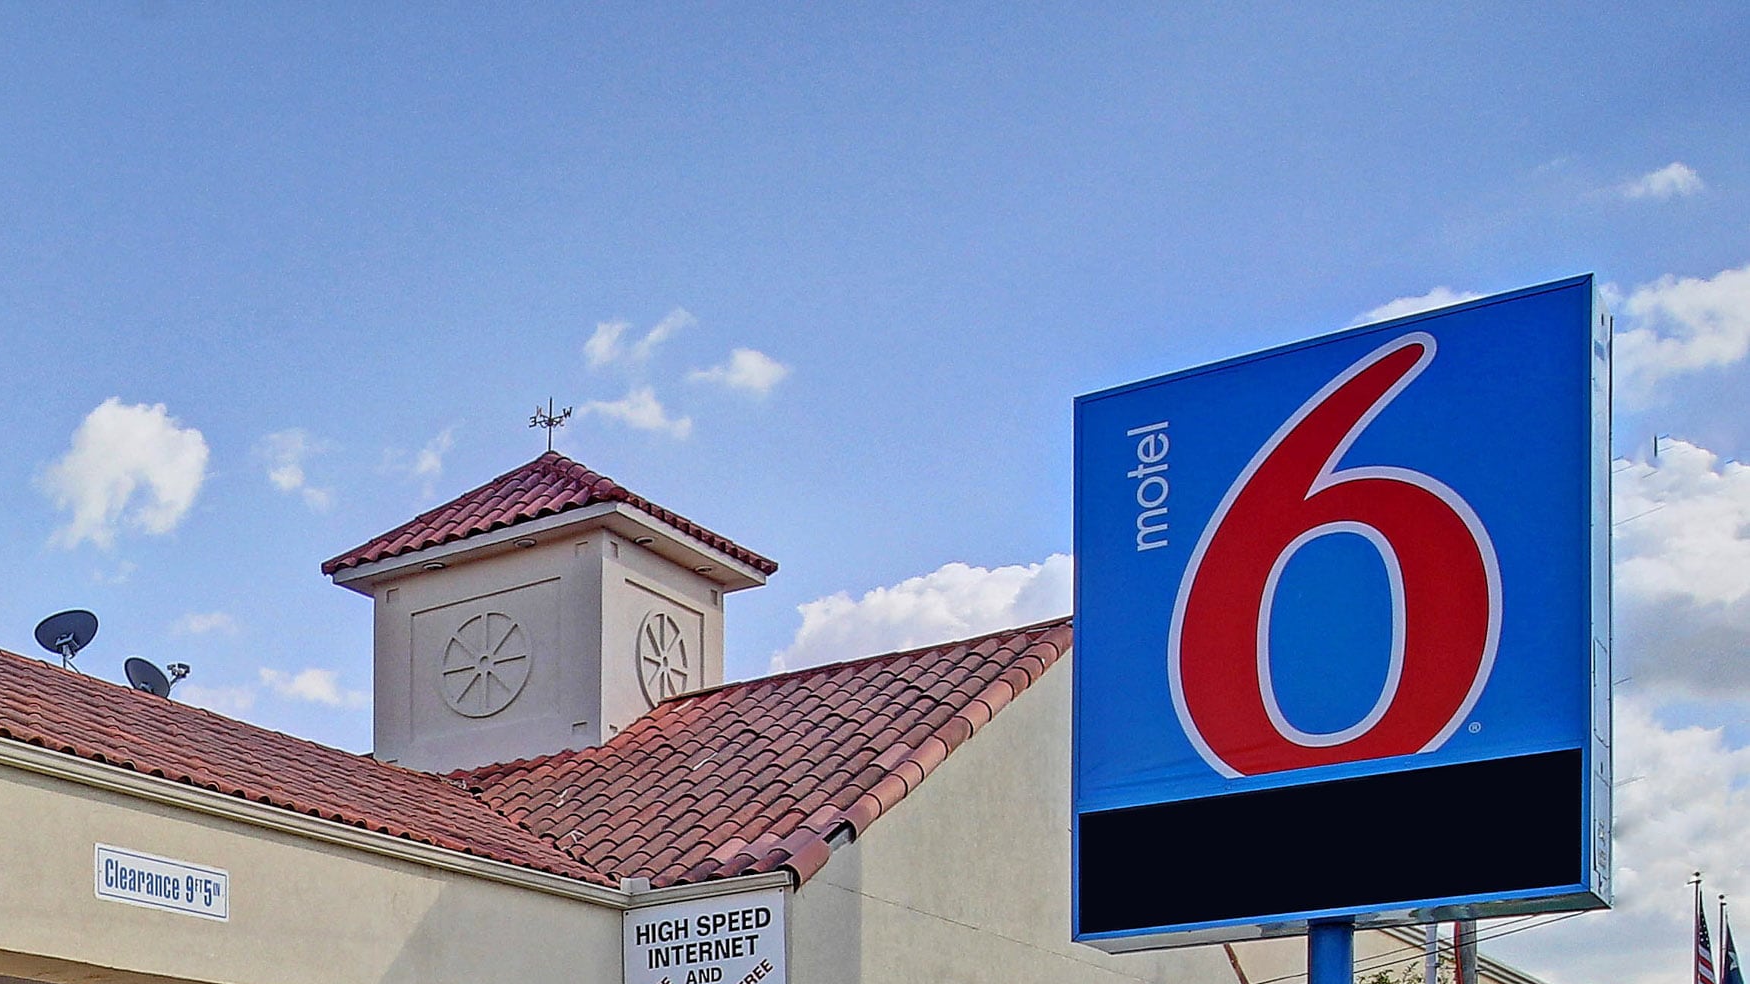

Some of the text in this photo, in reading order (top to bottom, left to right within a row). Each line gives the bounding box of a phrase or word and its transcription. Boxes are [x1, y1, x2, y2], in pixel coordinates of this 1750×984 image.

[1126, 420, 1169, 552] motel
[1167, 331, 1503, 778] 6
[105, 858, 180, 900] Clearance
[636, 907, 771, 945] HIGH SPEED
[648, 934, 759, 969] INTERNET
